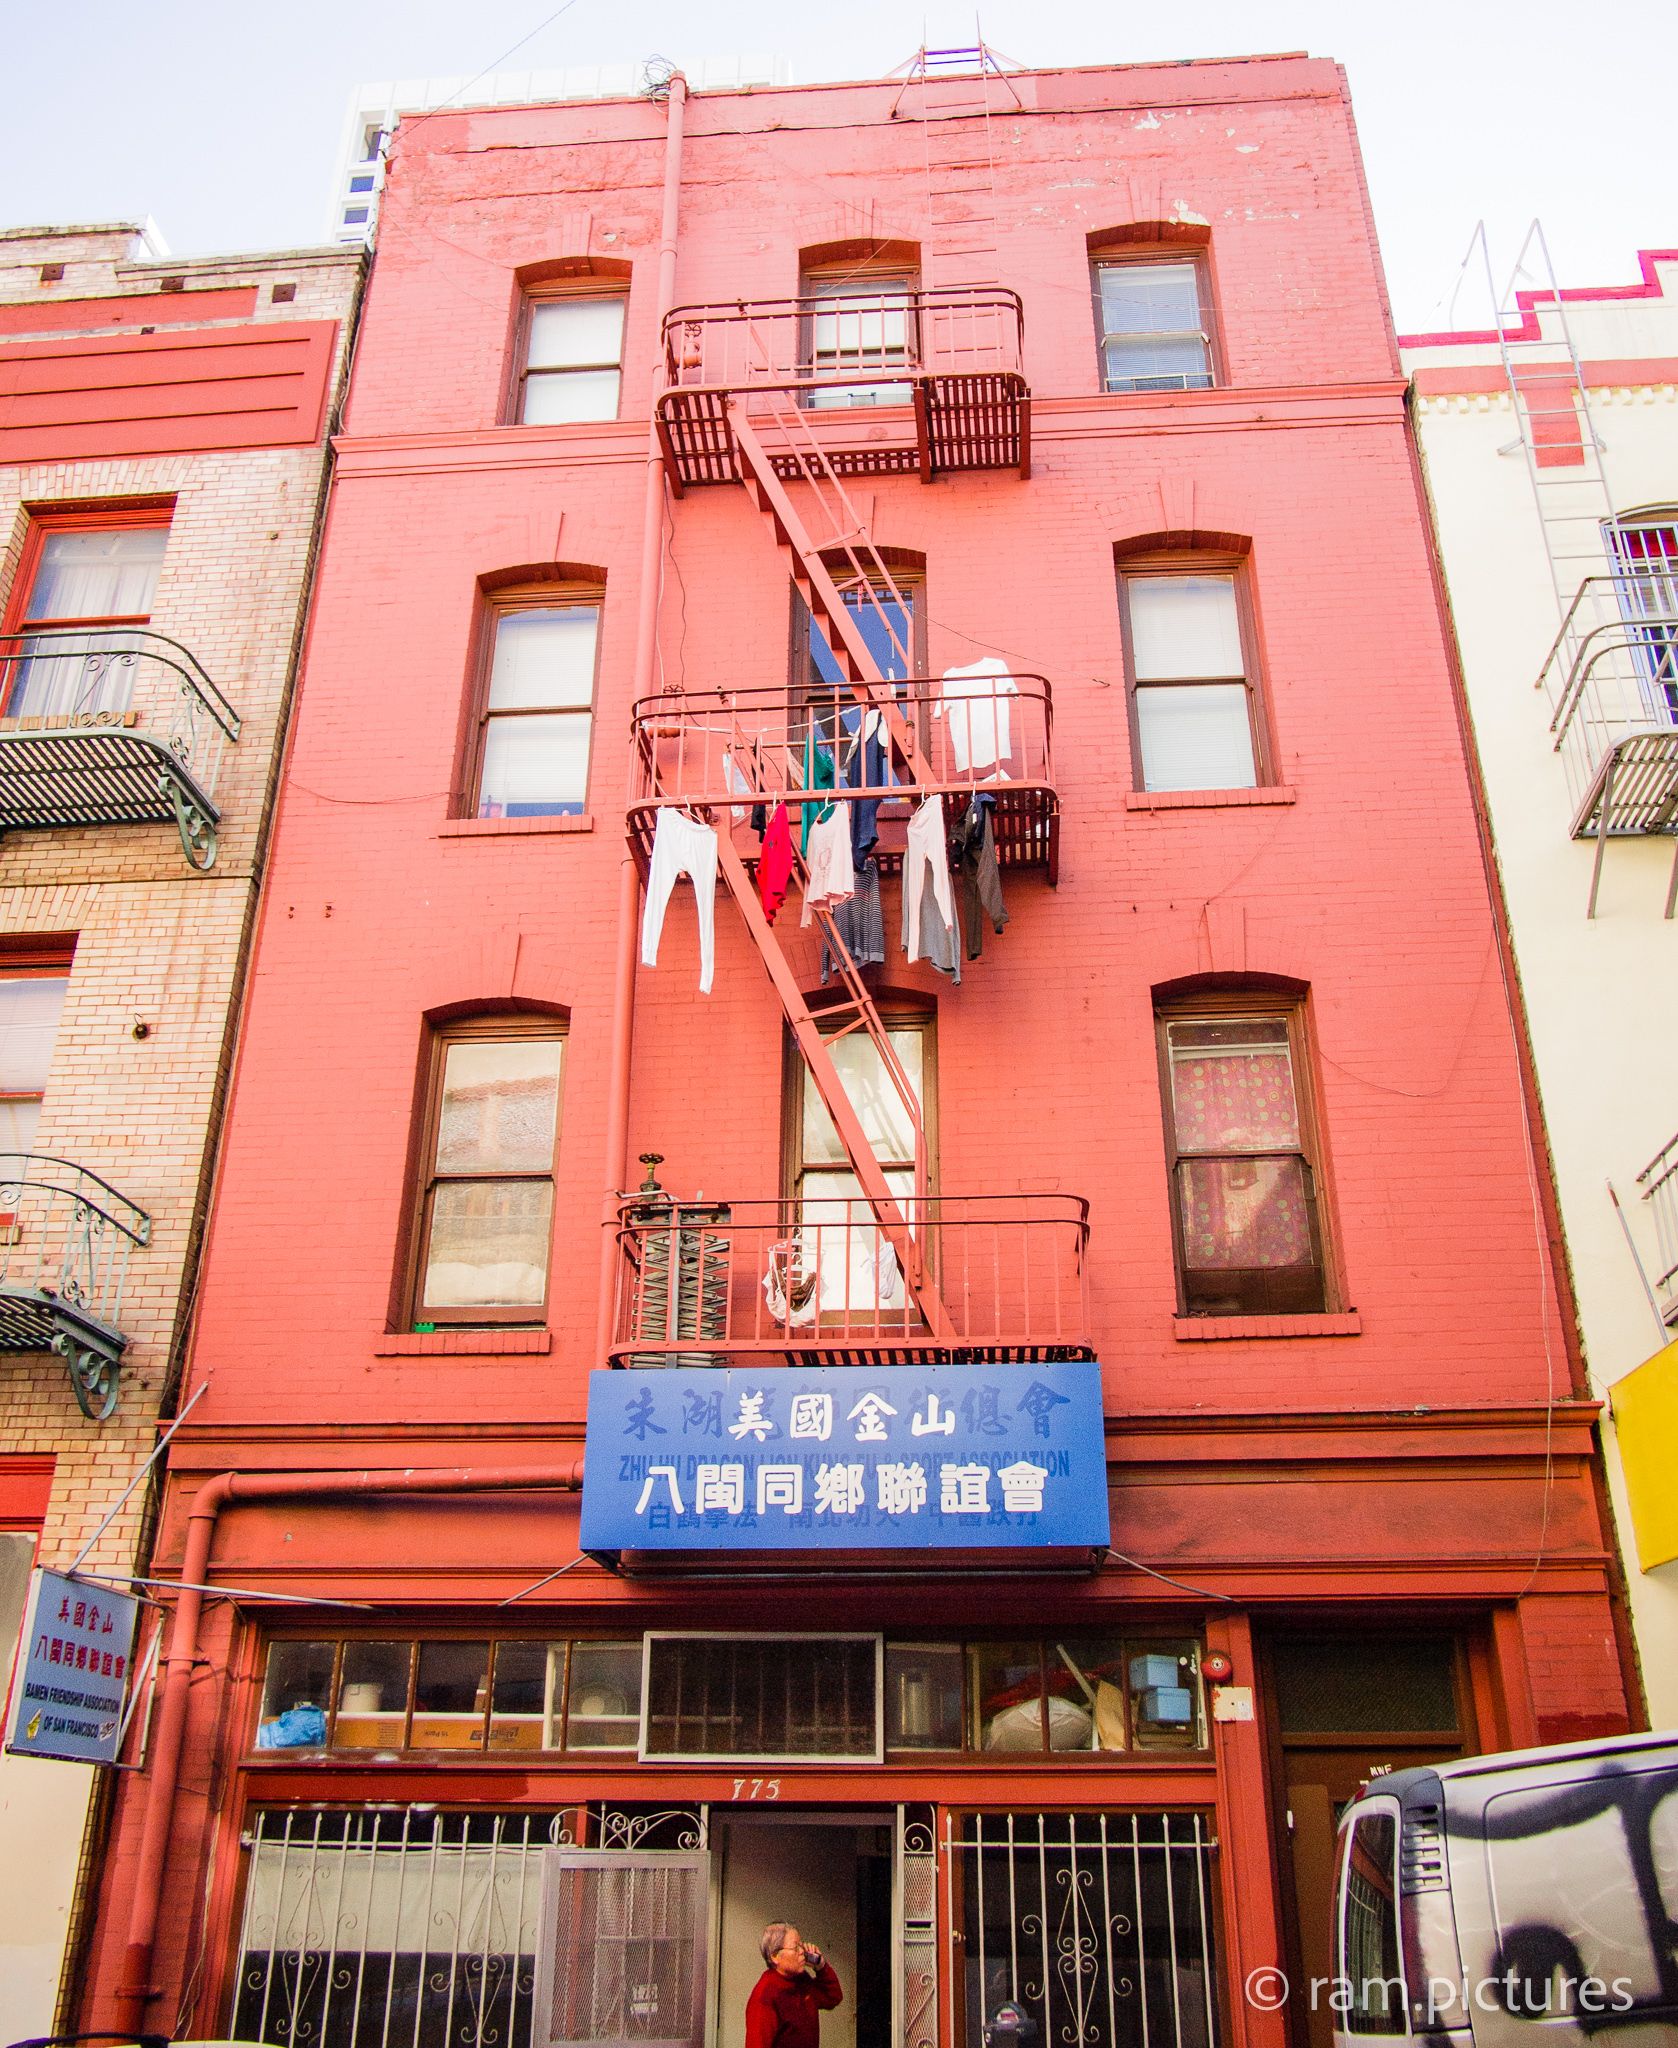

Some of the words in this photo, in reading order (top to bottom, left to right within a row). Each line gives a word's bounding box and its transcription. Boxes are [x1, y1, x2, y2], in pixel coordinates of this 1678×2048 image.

[728, 1390, 956, 1442] 美國金山
[635, 1460, 1049, 1515] 八閩同鄉聯誼會
[58, 1595, 113, 1633] 美國金山
[82, 1693, 120, 1714] ASSOCIATION
[43, 1715, 54, 1731] OF
[53, 1716, 67, 1733] SAN
[66, 1719, 99, 1739] FRANCISCO
[732, 1778, 781, 1800] 775
